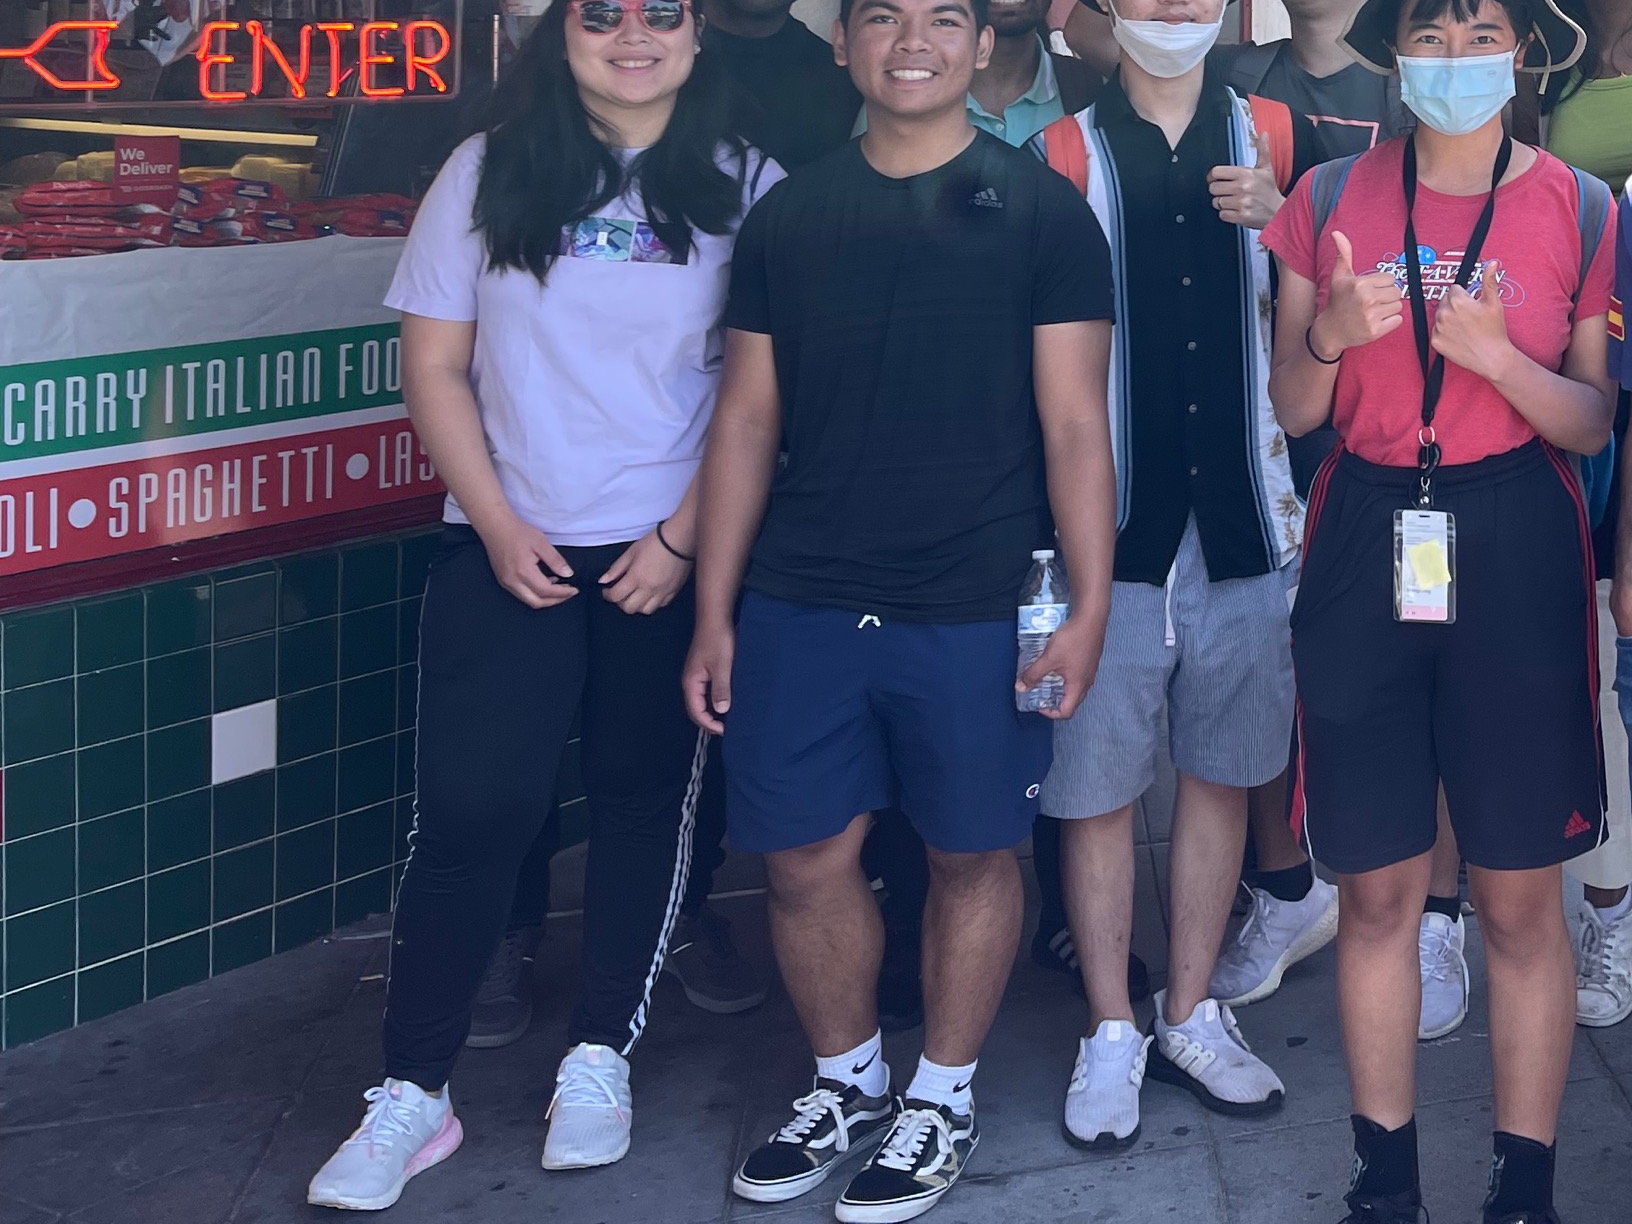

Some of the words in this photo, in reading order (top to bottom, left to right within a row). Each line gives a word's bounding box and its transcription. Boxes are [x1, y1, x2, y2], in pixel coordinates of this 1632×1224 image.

[197, 20, 451, 100] ENTER
[119, 147, 146, 161] We
[119, 161, 173, 176] Deliver
[4, 368, 147, 446] CARRY
[164, 346, 321, 424] ITALIAN
[108, 443, 335, 538] SPAGHETTI
